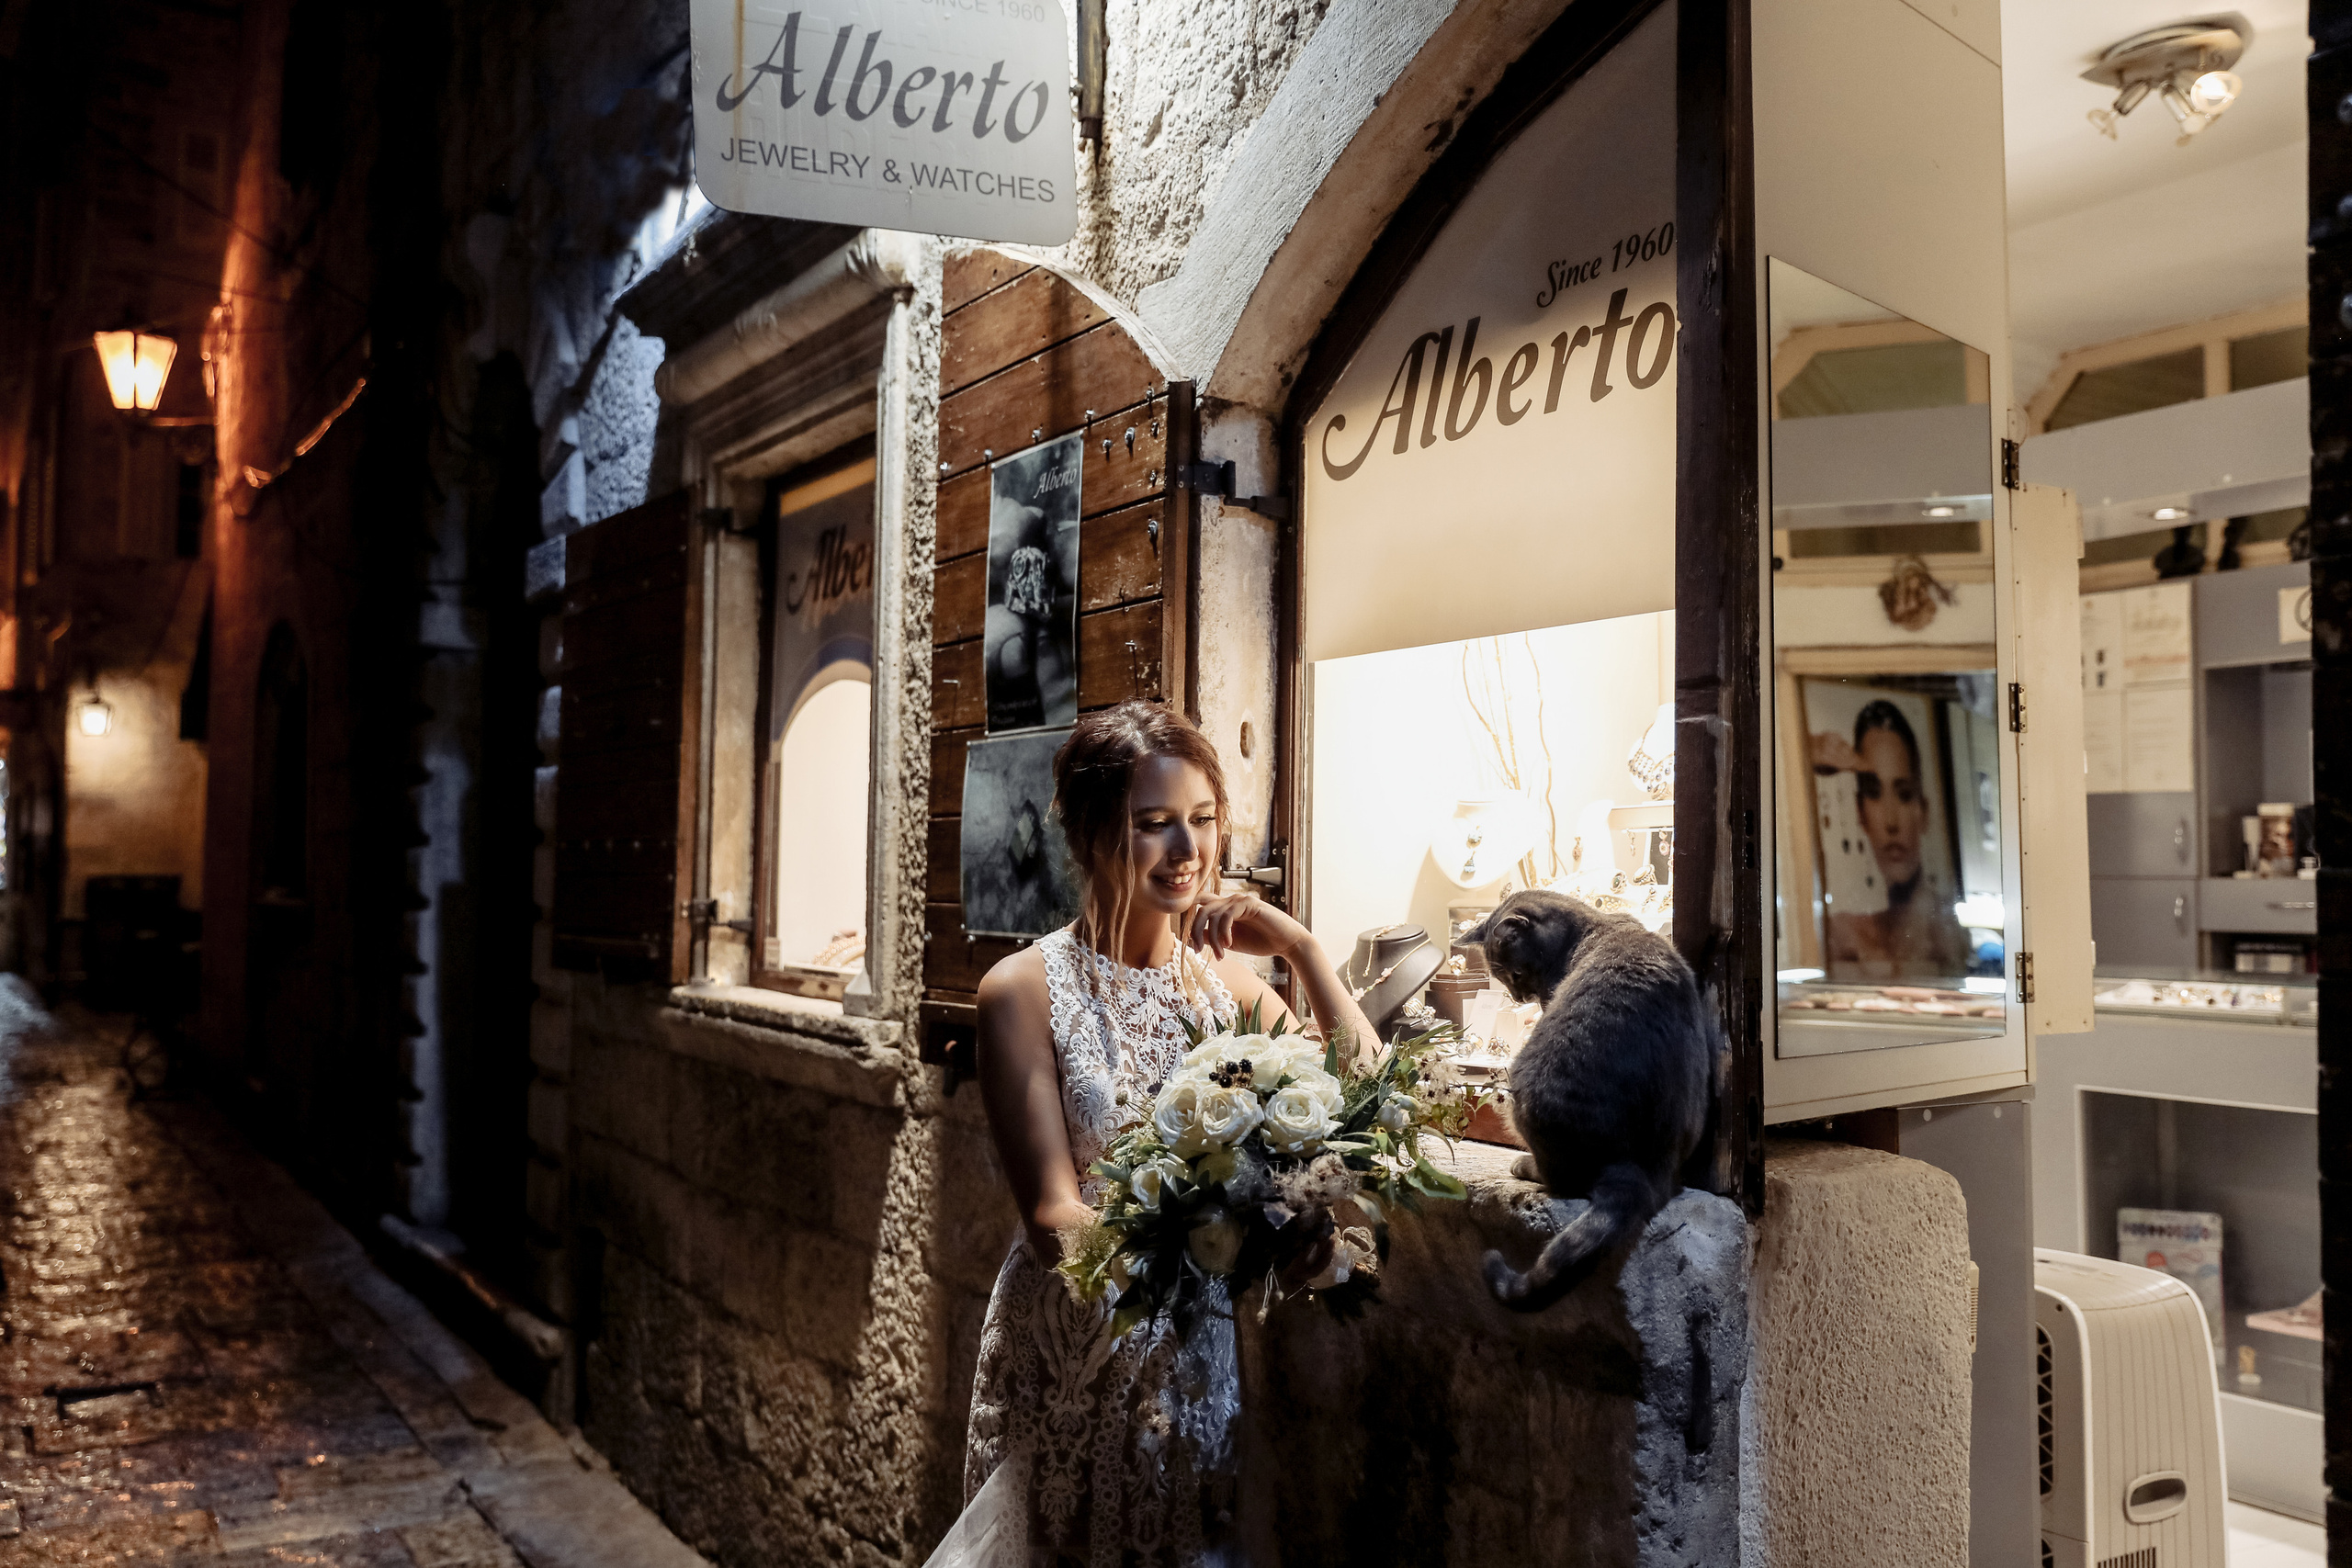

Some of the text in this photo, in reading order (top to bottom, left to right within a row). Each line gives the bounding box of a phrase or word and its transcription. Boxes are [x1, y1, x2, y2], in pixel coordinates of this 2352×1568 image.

[998, 0, 1046, 23] 1960
[716, 11, 1049, 143] Alberto
[720, 137, 1056, 203] JEWELRY & WATCHES
[1536, 221, 1675, 309] Since 1960
[1321, 288, 1676, 481] Alberto
[1033, 466, 1077, 499] Alberto
